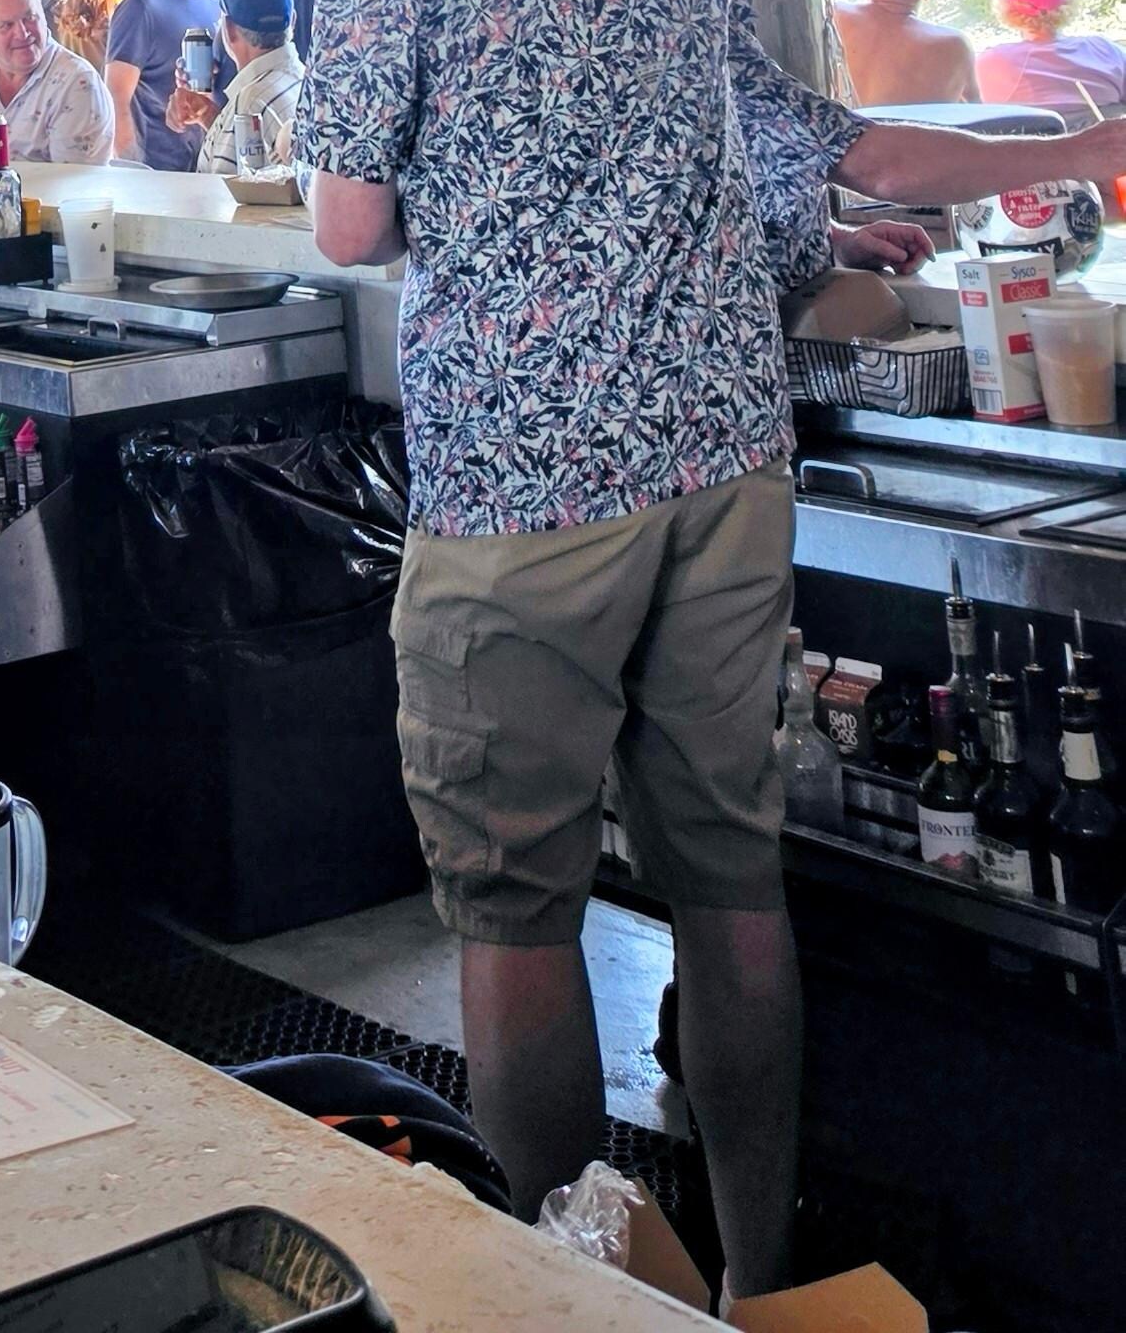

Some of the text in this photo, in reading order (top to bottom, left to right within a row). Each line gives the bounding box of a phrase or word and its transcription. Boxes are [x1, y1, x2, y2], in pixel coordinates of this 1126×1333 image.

[962, 269, 981, 281] Salt
[1011, 266, 1037, 282] Sysco
[1009, 284, 1043, 301] Classic
